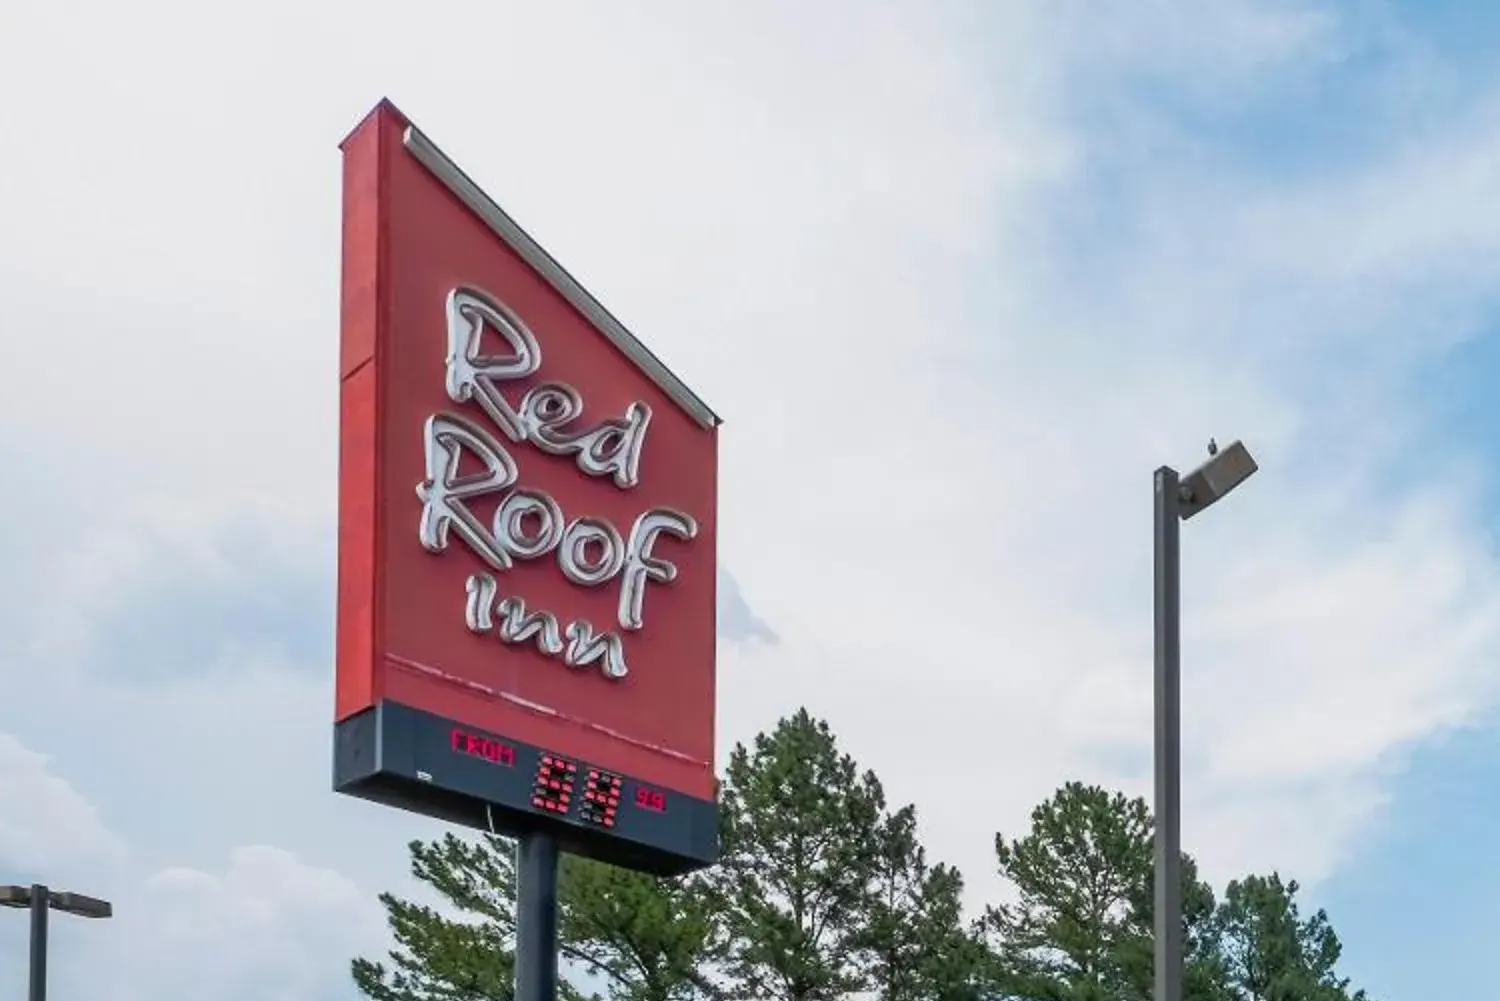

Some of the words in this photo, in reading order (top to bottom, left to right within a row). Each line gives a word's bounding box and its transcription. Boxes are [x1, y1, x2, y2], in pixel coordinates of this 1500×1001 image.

[445, 287, 653, 489] Red
[416, 413, 698, 630] Roof
[465, 571, 629, 679] Inn
[451, 730, 515, 767] FROM
